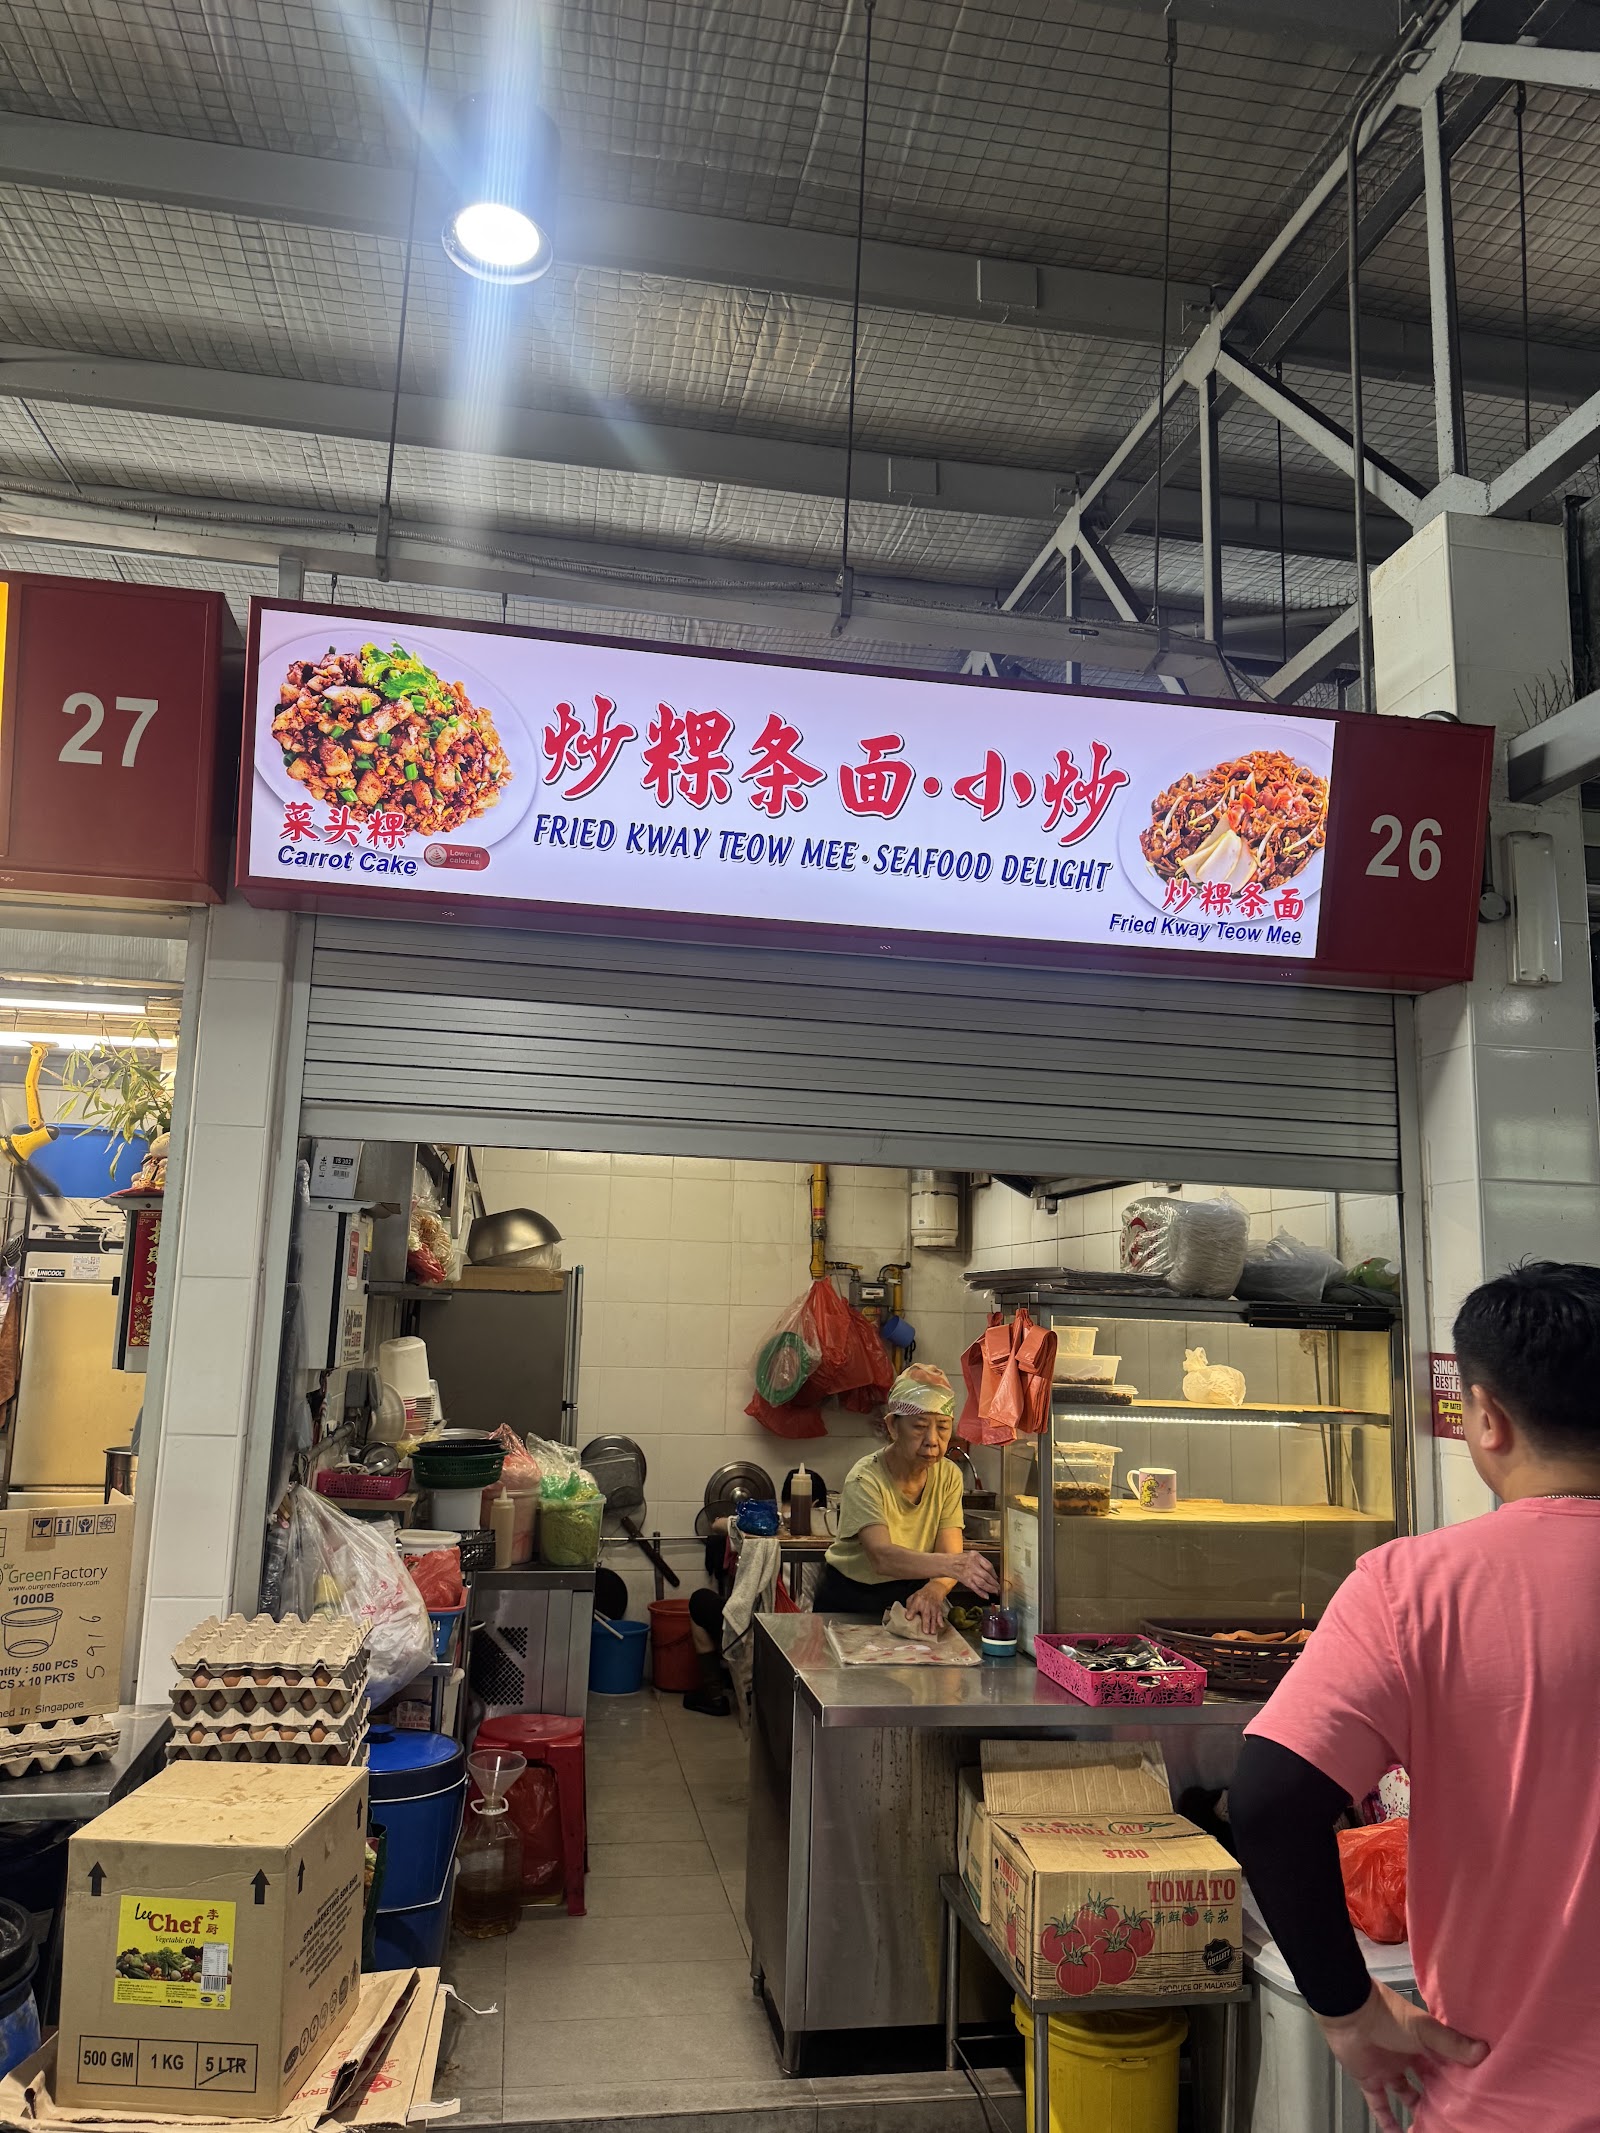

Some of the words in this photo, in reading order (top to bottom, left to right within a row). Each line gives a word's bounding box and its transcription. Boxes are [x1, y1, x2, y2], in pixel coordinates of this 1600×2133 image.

[58, 692, 159, 768] 27
[278, 801, 409, 850] 菜头粿
[449, 849, 473, 859] Lower
[533, 814, 616, 850] FRIED
[625, 822, 710, 858] KWAY
[718, 830, 794, 867] TEOW
[1001, 854, 1113, 892] DELIGHT
[1364, 814, 1442, 881] 26
[277, 845, 353, 869] Carrot
[359, 852, 419, 876] Cake
[449, 857, 480, 866] calories
[1161, 878, 1306, 922] 炒粿条面
[1109, 913, 1157, 933] Fried
[1161, 917, 1211, 941] Kway
[1216, 922, 1263, 943] Teow
[1266, 925, 1302, 945] Mee
[38, 1269, 65, 1277] UNICOOL
[1433, 1359, 1460, 1376] SINGA
[1435, 1375, 1454, 1390] BEST
[1447, 1392, 1460, 1400] ENJ
[1452, 1425, 1464, 1435] 202
[8, 1566, 109, 1583] GreenFactory
[8, 1579, 101, 1592] www.ourgreenfactory.com
[13, 1592, 55, 1606] 1000B
[0, 1665, 22, 1677] ntity
[32, 1662, 52, 1673] 500
[54, 1659, 79, 1671] PCS
[0, 1679, 15, 1690] CS
[18, 1680, 25, 1688] x
[29, 1677, 41, 1687] 10
[44, 1672, 76, 1685] PKTS
[0, 1706, 15, 1718] ned
[20, 1707, 31, 1716] In
[34, 1700, 85, 1714] Singapore
[1020, 1826, 1111, 1837] TOMATO
[1101, 1848, 1150, 1860] 3730
[1147, 1878, 1236, 1903] TOMATO
[134, 1902, 153, 1921] Lee
[1203, 1908, 1229, 1925] 番茄
[148, 1913, 204, 1934] Chef
[205, 1908, 220, 1936] 李厨
[155, 1935, 185, 1945] Vegetable
[185, 1937, 196, 1945] Oil
[1207, 1948, 1232, 1966] QUALITY
[1158, 1983, 1192, 1993] PRODUCE
[1204, 1980, 1238, 1990] MALAYSIA
[83, 2050, 107, 2067] 500
[111, 2051, 134, 2068] GM
[151, 2053, 157, 2069] 1
[162, 2054, 184, 2070] KG
[205, 2056, 215, 2072] 5
[218, 2057, 247, 2074] LTR
